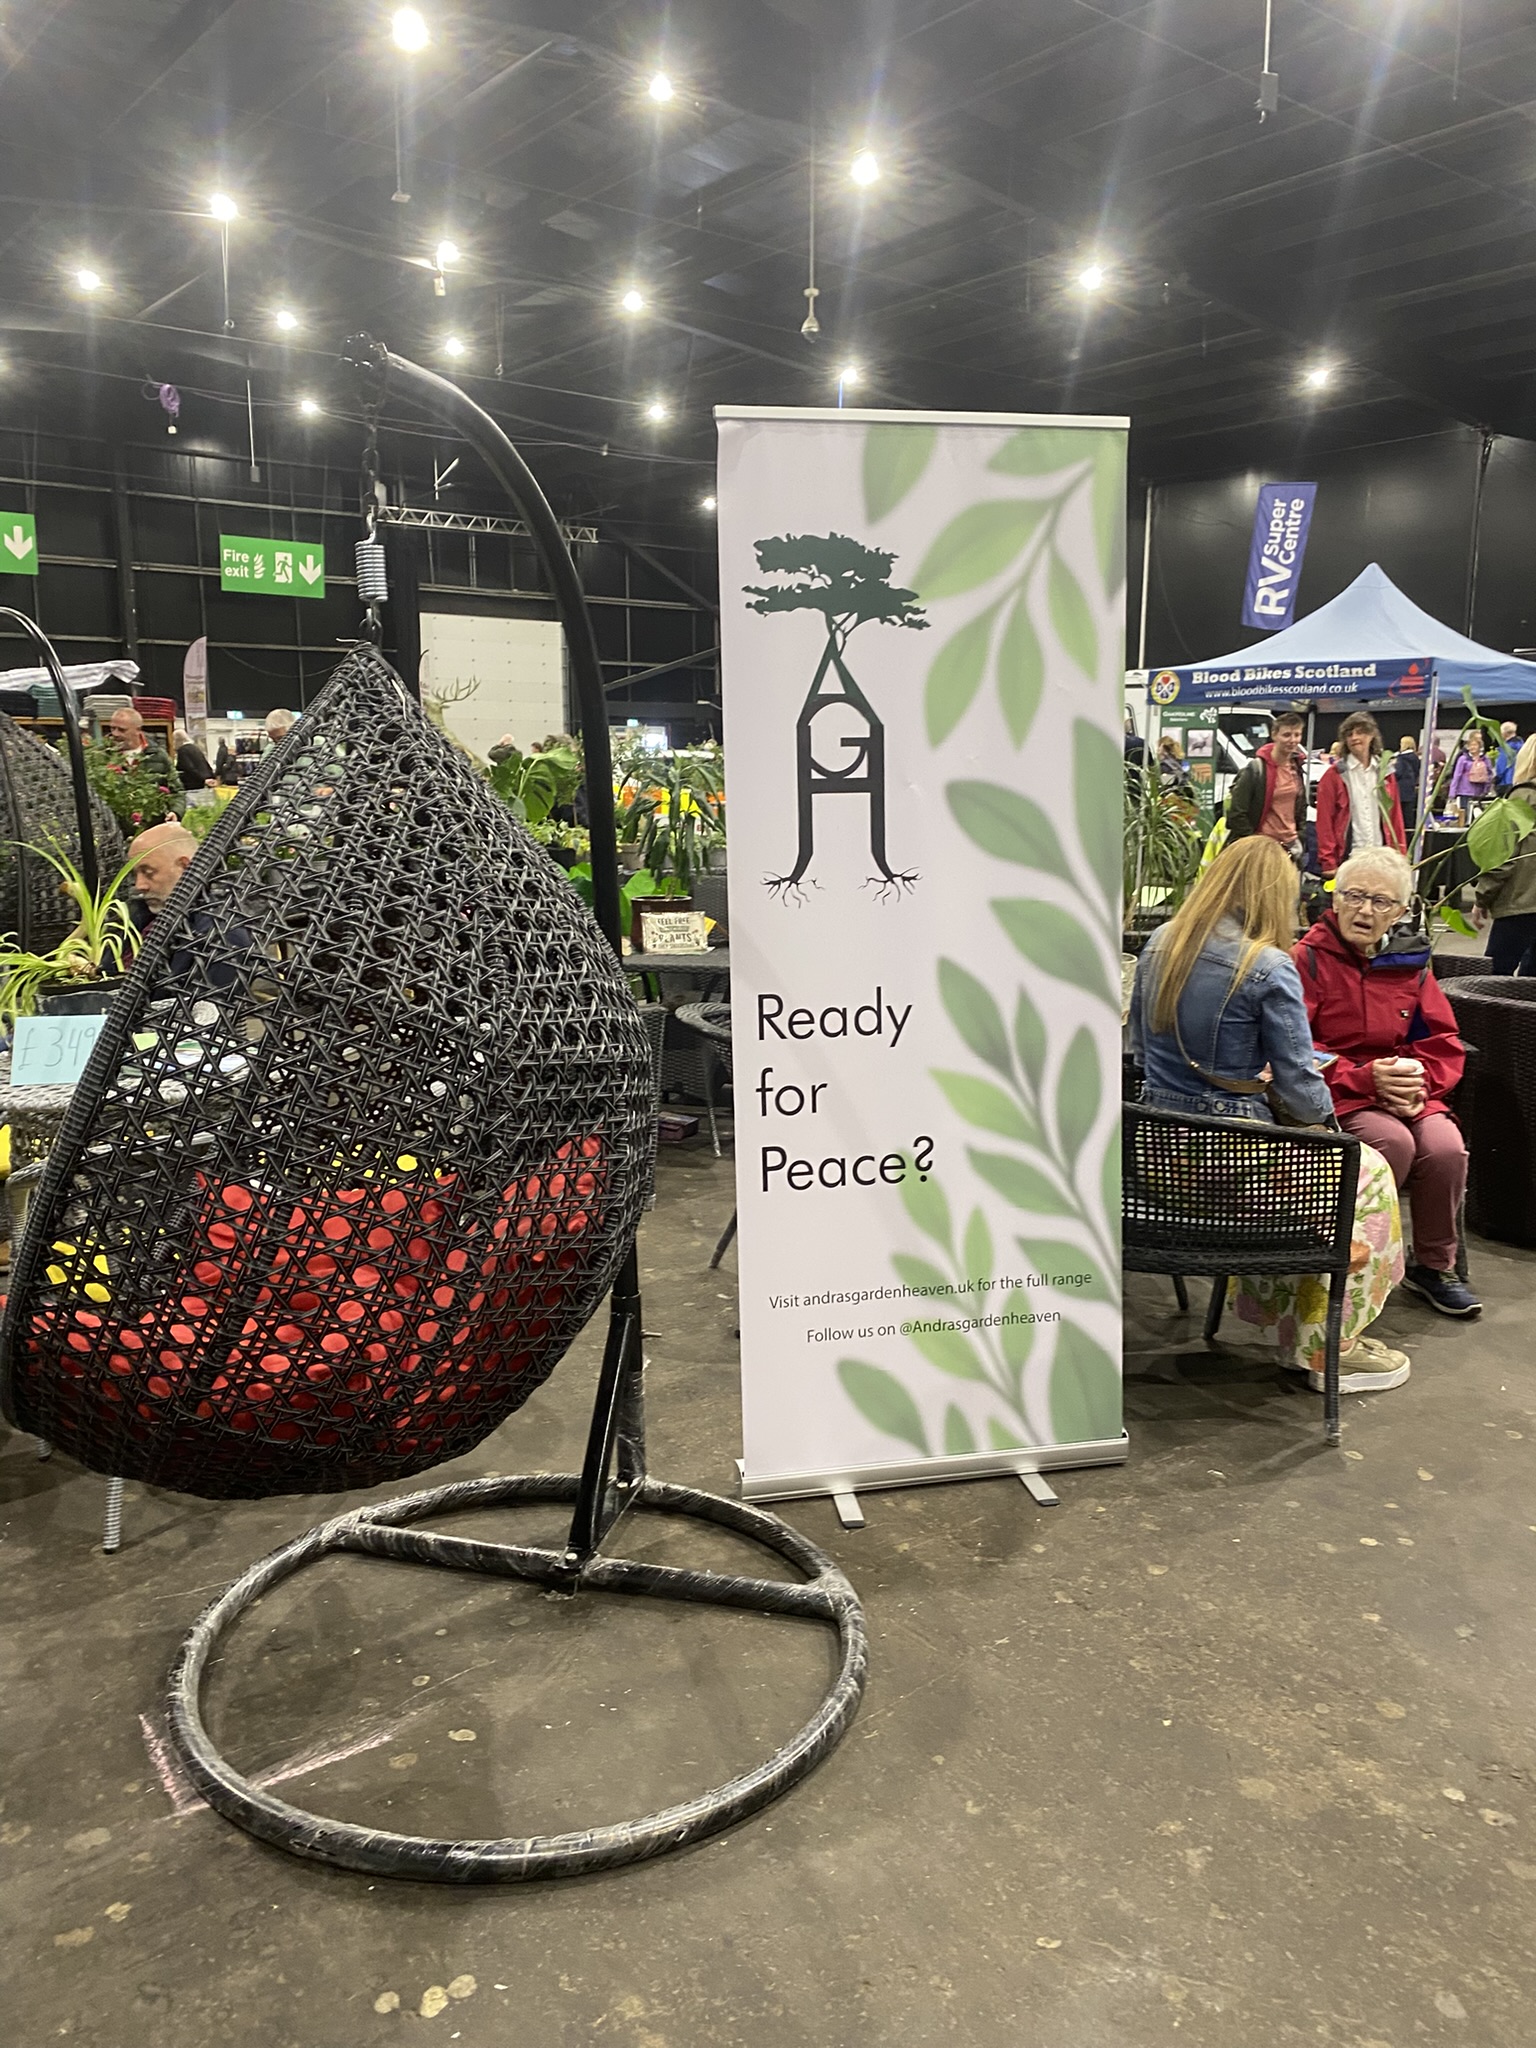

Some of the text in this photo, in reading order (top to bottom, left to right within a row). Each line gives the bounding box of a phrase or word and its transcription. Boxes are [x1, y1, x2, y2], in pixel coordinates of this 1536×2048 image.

[223, 548, 250, 564] Fire
[224, 564, 250, 578] exit
[1253, 556, 1293, 616] RV
[1191, 663, 1377, 685] Blood Bikes Scotland
[1205, 682, 1359, 699] www.bloodbikesscotland.co.uk
[757, 985, 912, 1048] Ready
[756, 1067, 828, 1117] for
[762, 1135, 934, 1192] Peace?
[769, 1273, 1093, 1309] Visit andrasgardenheaven.uk for the full range
[807, 1311, 1061, 1343] Follow us on @Andrasgardenheaven
